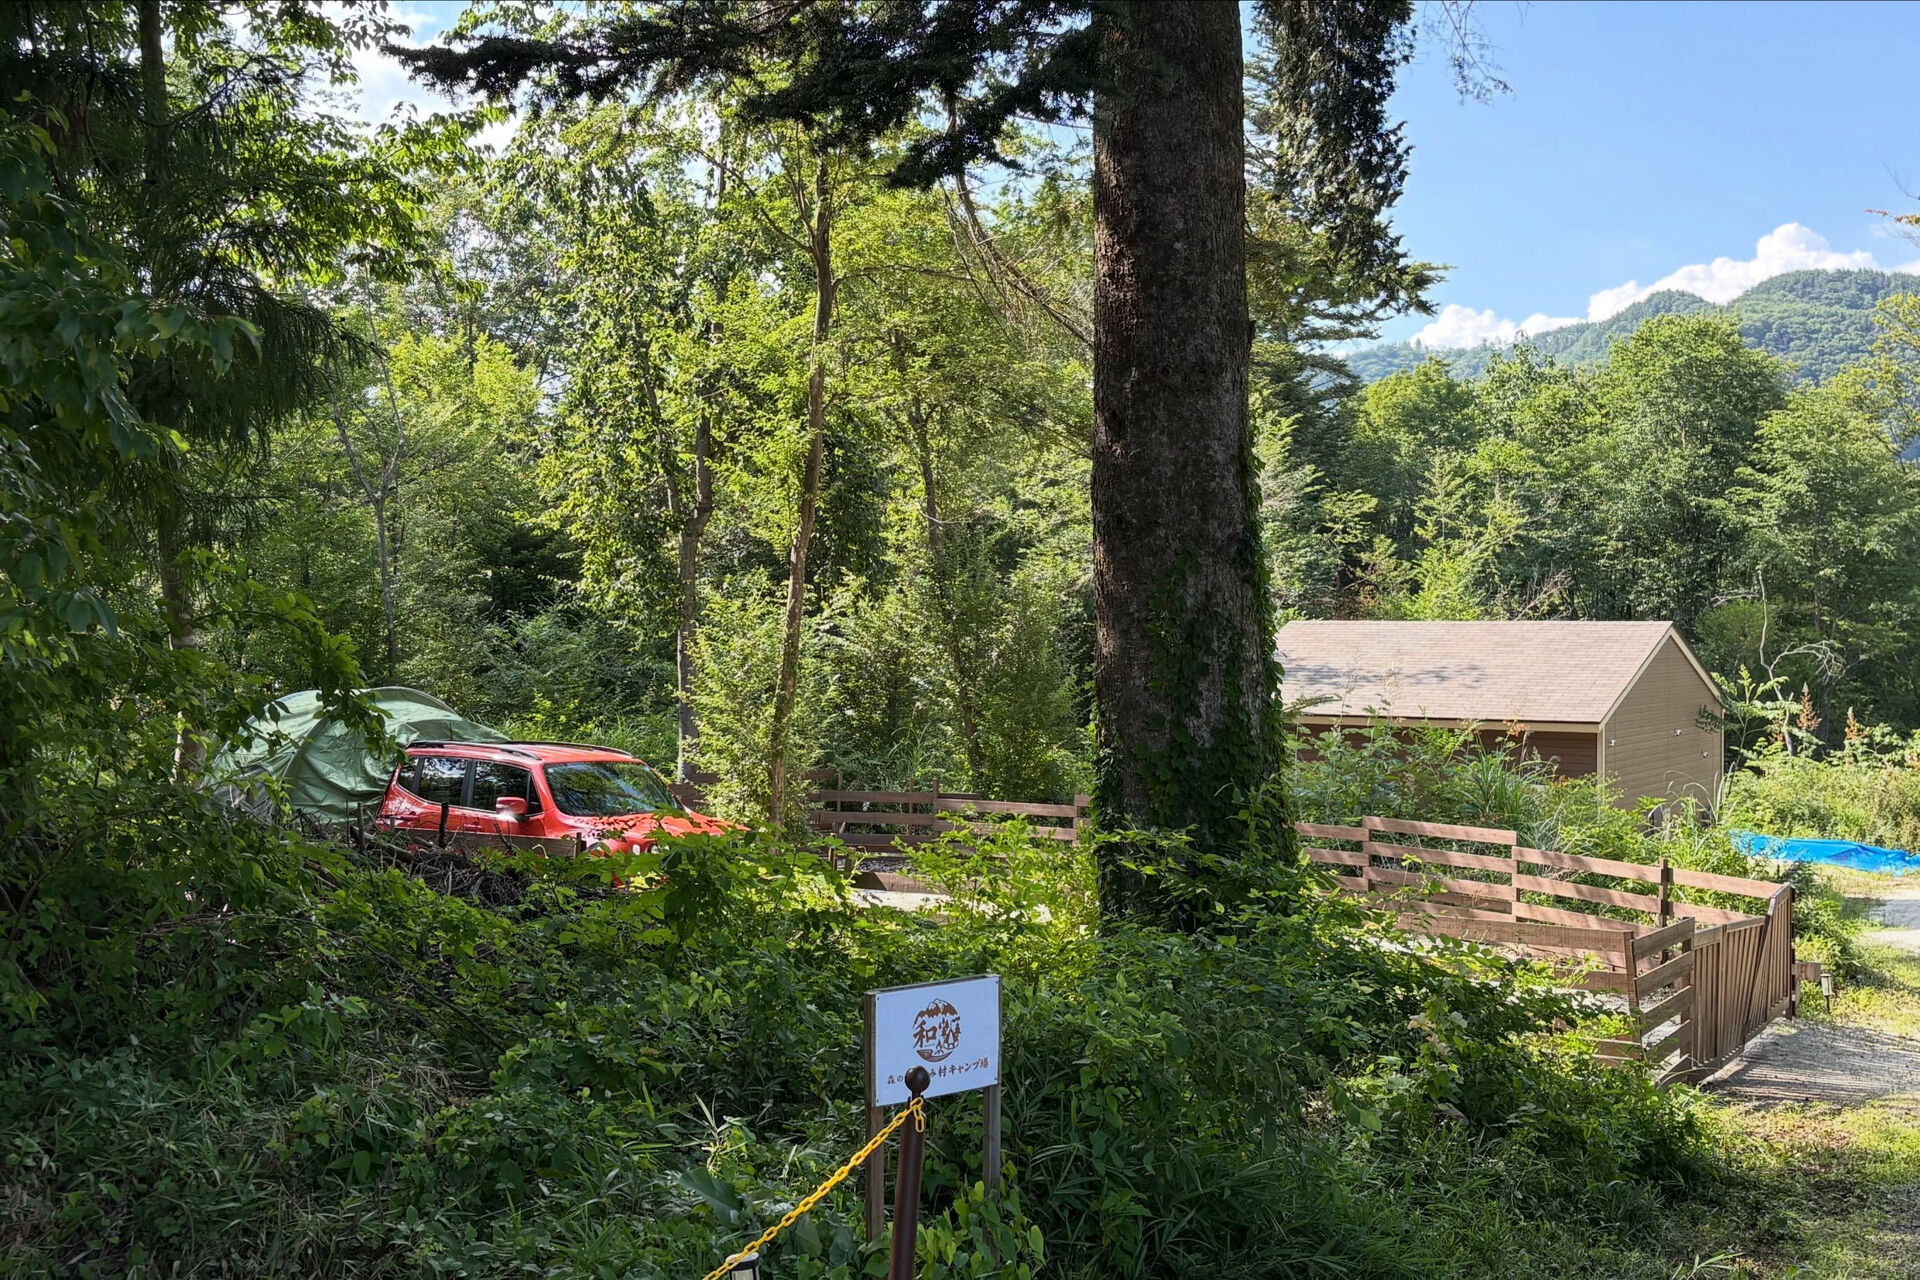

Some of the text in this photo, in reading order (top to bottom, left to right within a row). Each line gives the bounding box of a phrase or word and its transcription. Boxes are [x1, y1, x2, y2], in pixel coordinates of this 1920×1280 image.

[887, 1057, 989, 1085] 森のみ村キャンプ場
